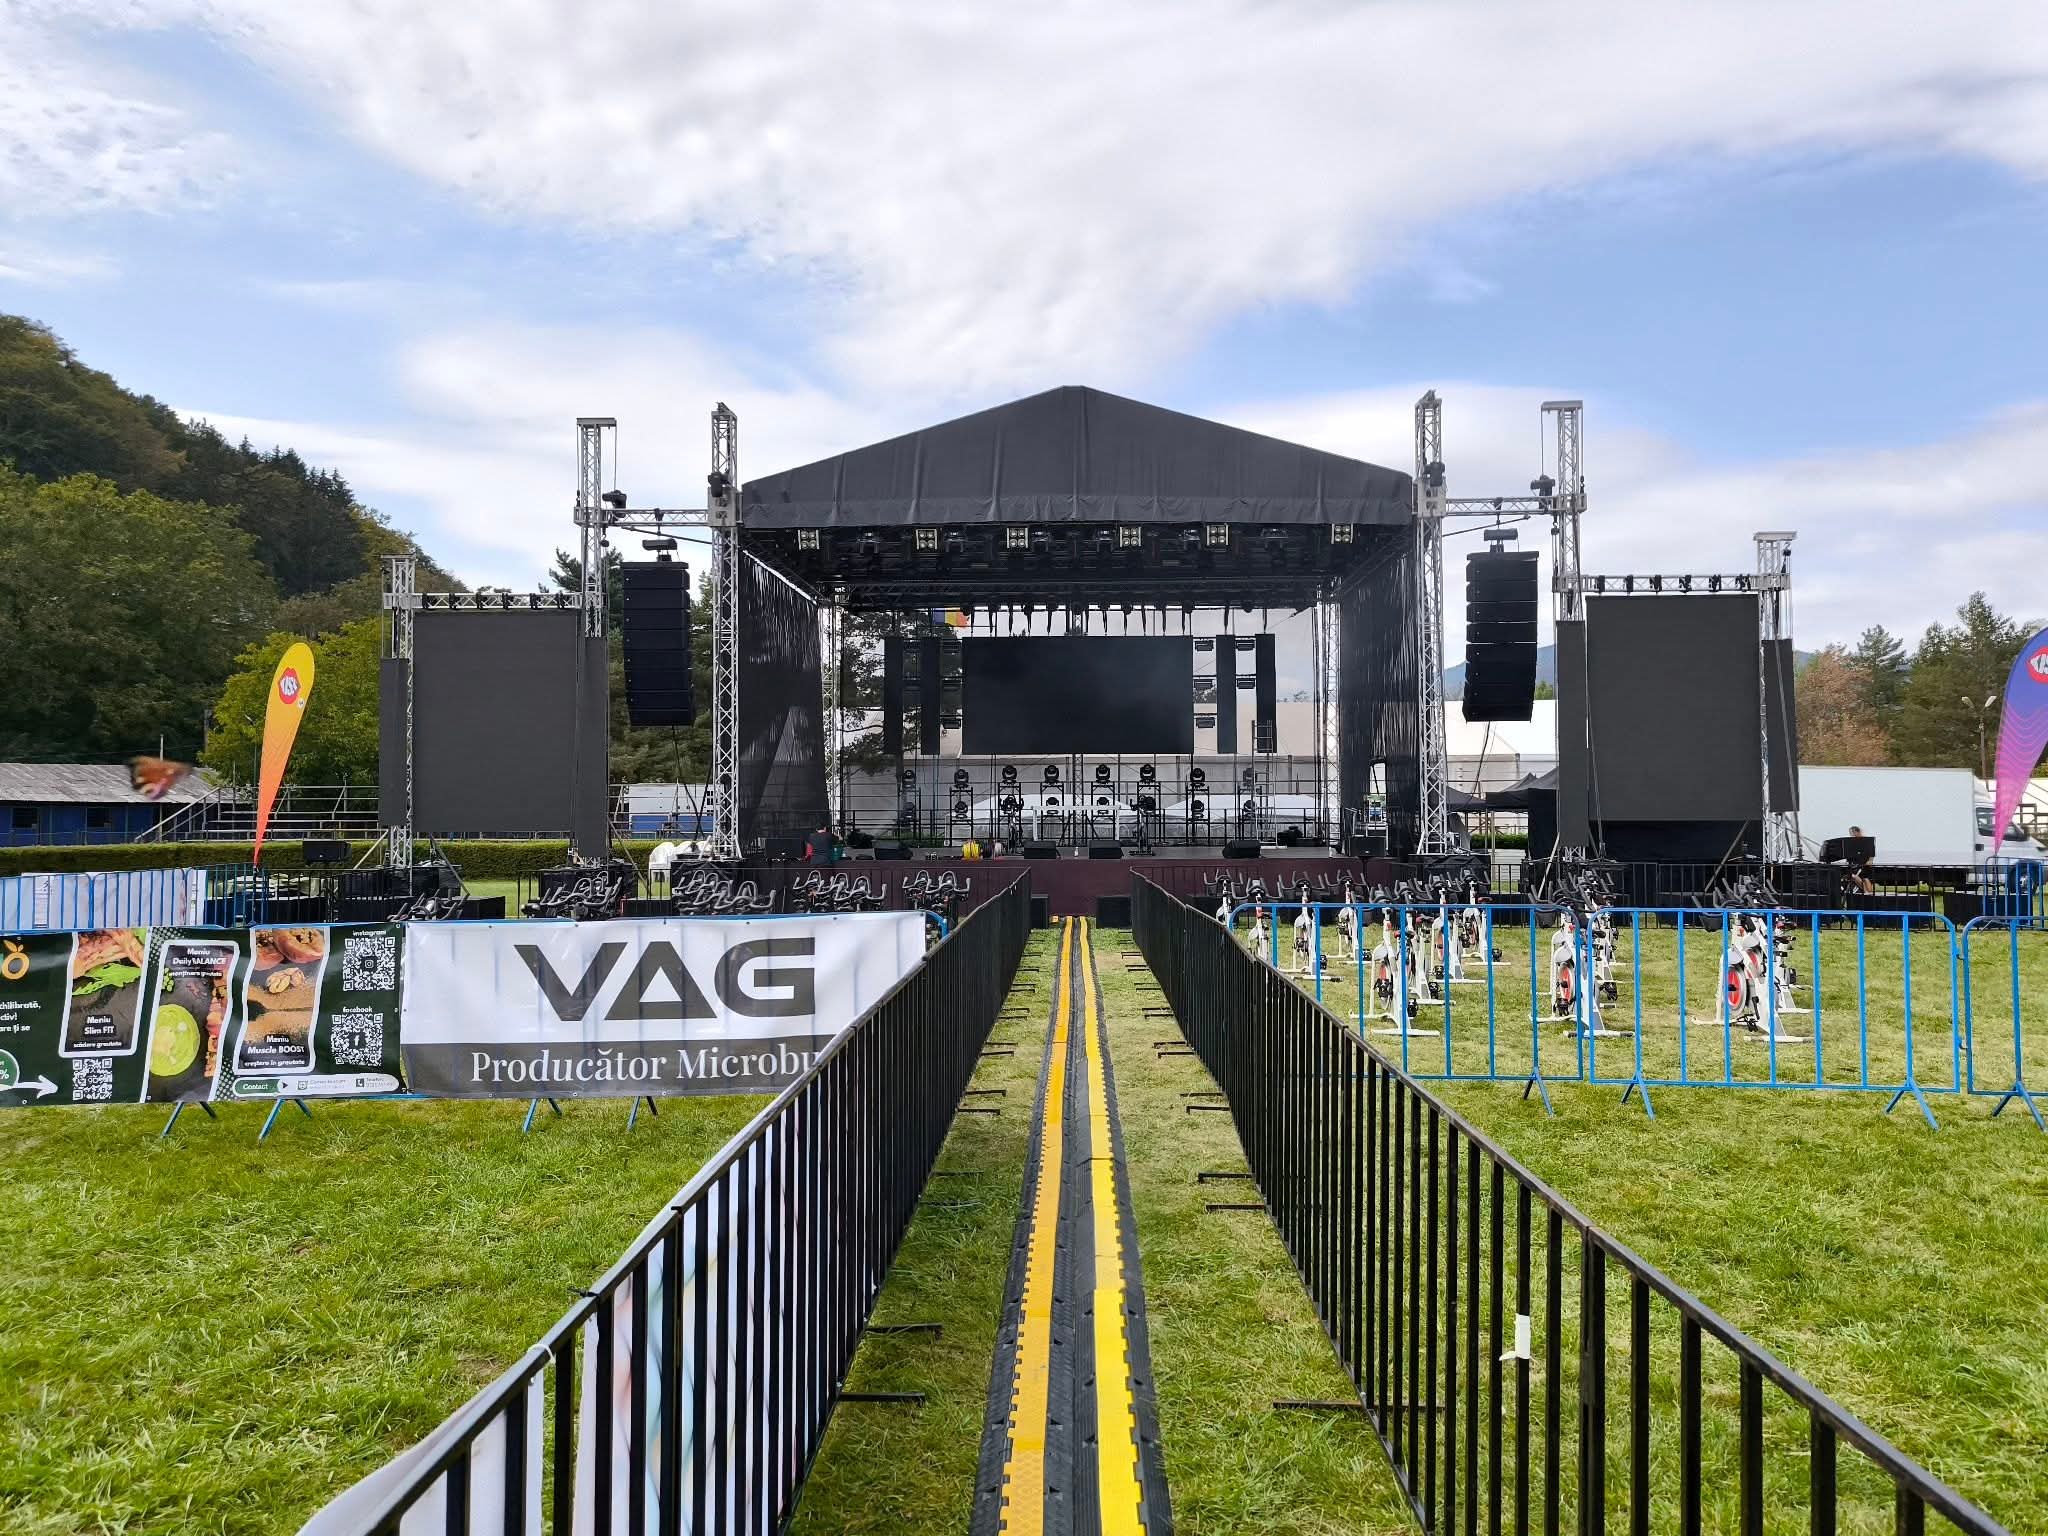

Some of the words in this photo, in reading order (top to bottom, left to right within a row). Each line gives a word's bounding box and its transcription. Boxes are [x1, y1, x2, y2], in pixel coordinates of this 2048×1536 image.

[172, 957, 191, 966] Daily
[192, 957, 227, 965] BALANCE
[514, 937, 815, 1021] VAG
[342, 1005, 373, 1013] facebook
[86, 1016, 111, 1024] Meniu
[84, 1026, 102, 1035] Slim
[103, 1026, 115, 1034] FIT
[266, 1035, 290, 1043] Meniu
[247, 1046, 277, 1054] Muscle
[278, 1045, 305, 1053] BOOST
[471, 1047, 666, 1083] Producător
[242, 1082, 269, 1090] Contact
